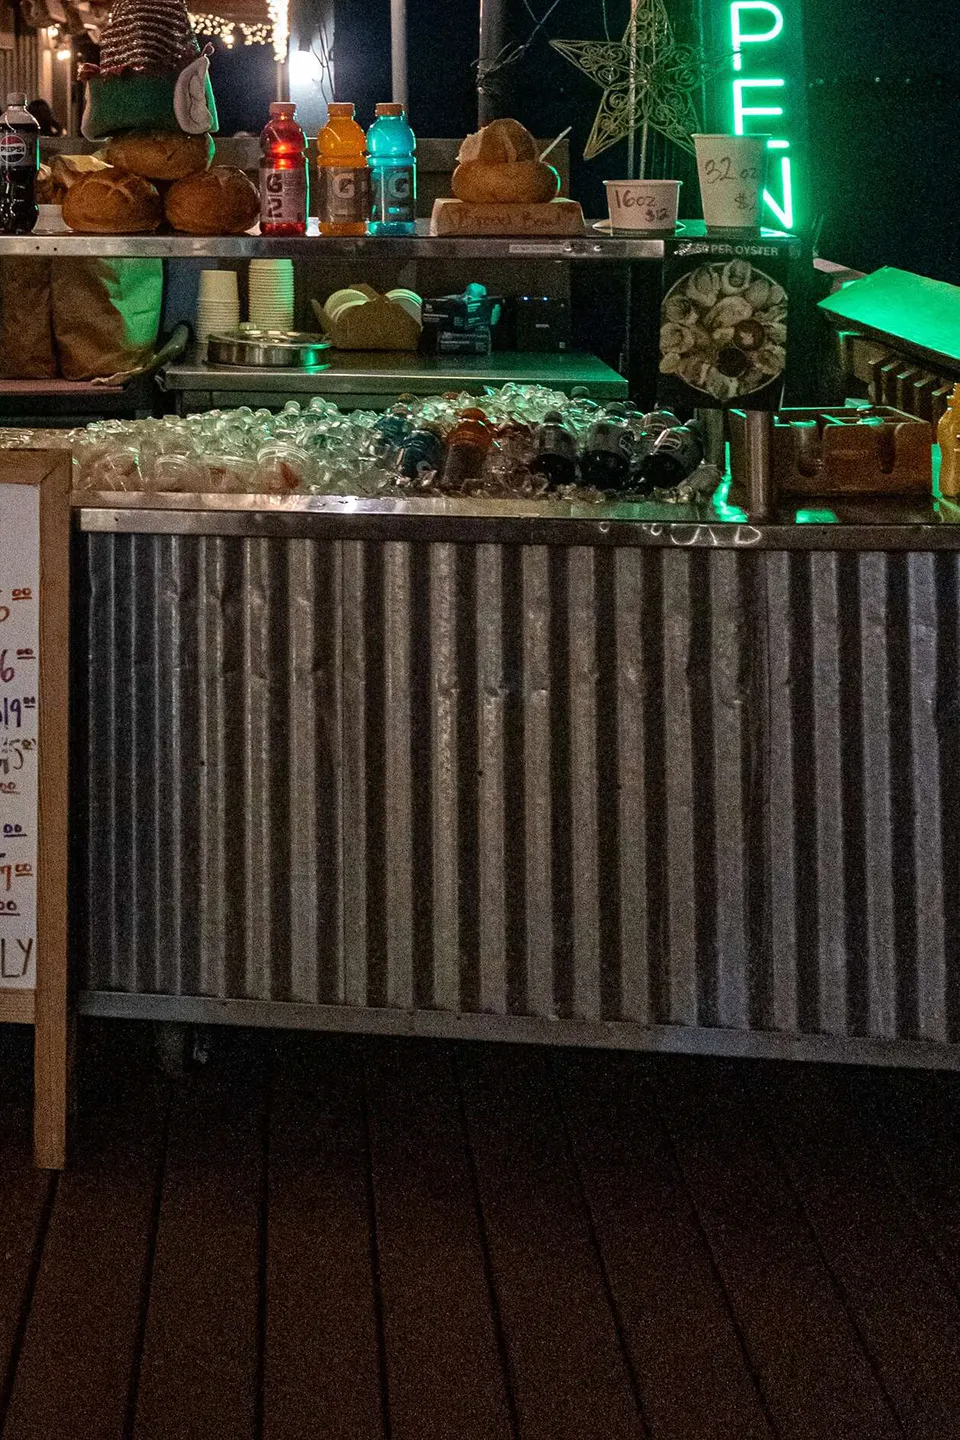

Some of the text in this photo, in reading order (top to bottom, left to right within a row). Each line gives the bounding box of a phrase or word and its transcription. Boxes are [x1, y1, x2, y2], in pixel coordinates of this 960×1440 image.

[0, 145, 25, 153] PEPSI
[704, 156, 738, 184] 32
[711, 244, 733, 254] PER
[735, 245, 779, 256] OYSTER
